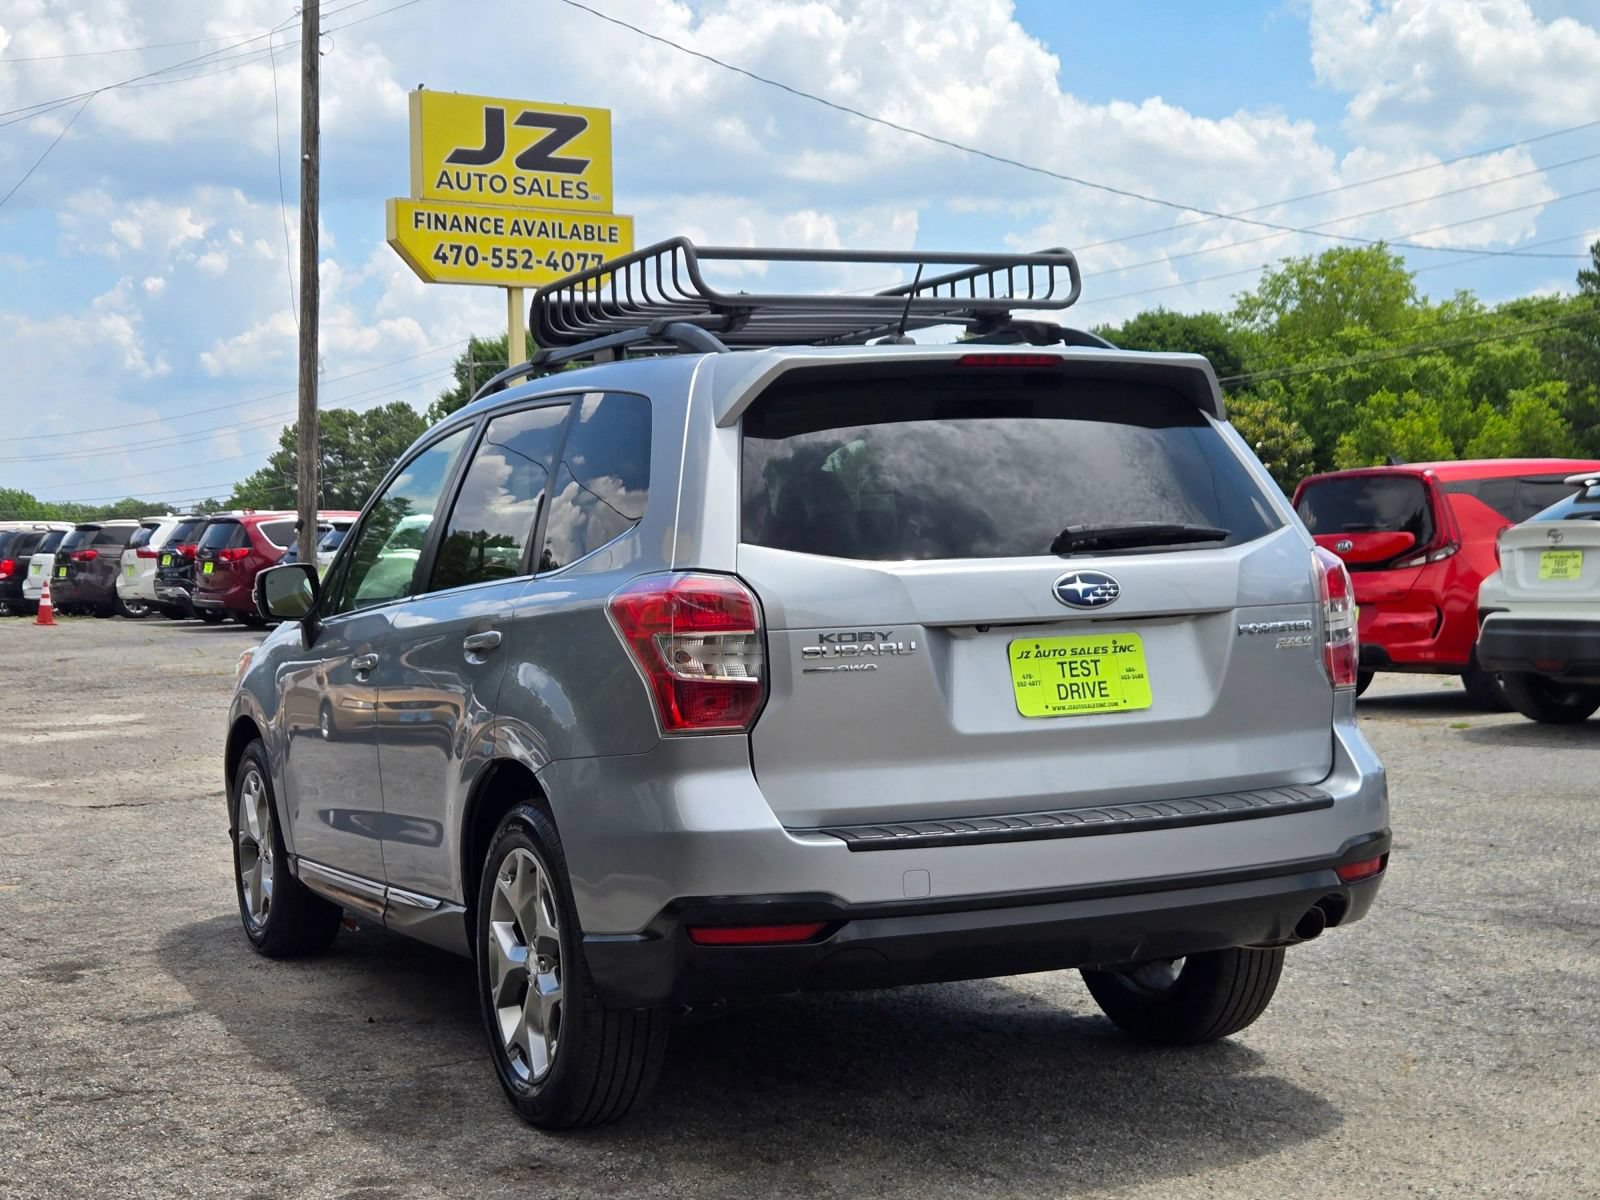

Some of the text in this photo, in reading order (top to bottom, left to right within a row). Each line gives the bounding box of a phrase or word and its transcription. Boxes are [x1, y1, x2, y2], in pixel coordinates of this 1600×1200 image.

[444, 106, 592, 175] JZ
[436, 170, 507, 194] AUTO
[513, 176, 590, 200] SALES
[413, 211, 619, 244] FINANCE AVAILABLE
[433, 243, 604, 273] 470-552-4077
[818, 631, 894, 644] KOBY
[802, 641, 917, 659] SUBARU
[1016, 650, 1031, 660] JZ
[1034, 649, 1067, 659] AUTO
[1070, 645, 1108, 656] SALES
[1056, 659, 1101, 679] TEST
[1056, 680, 1110, 701] DRIVE
